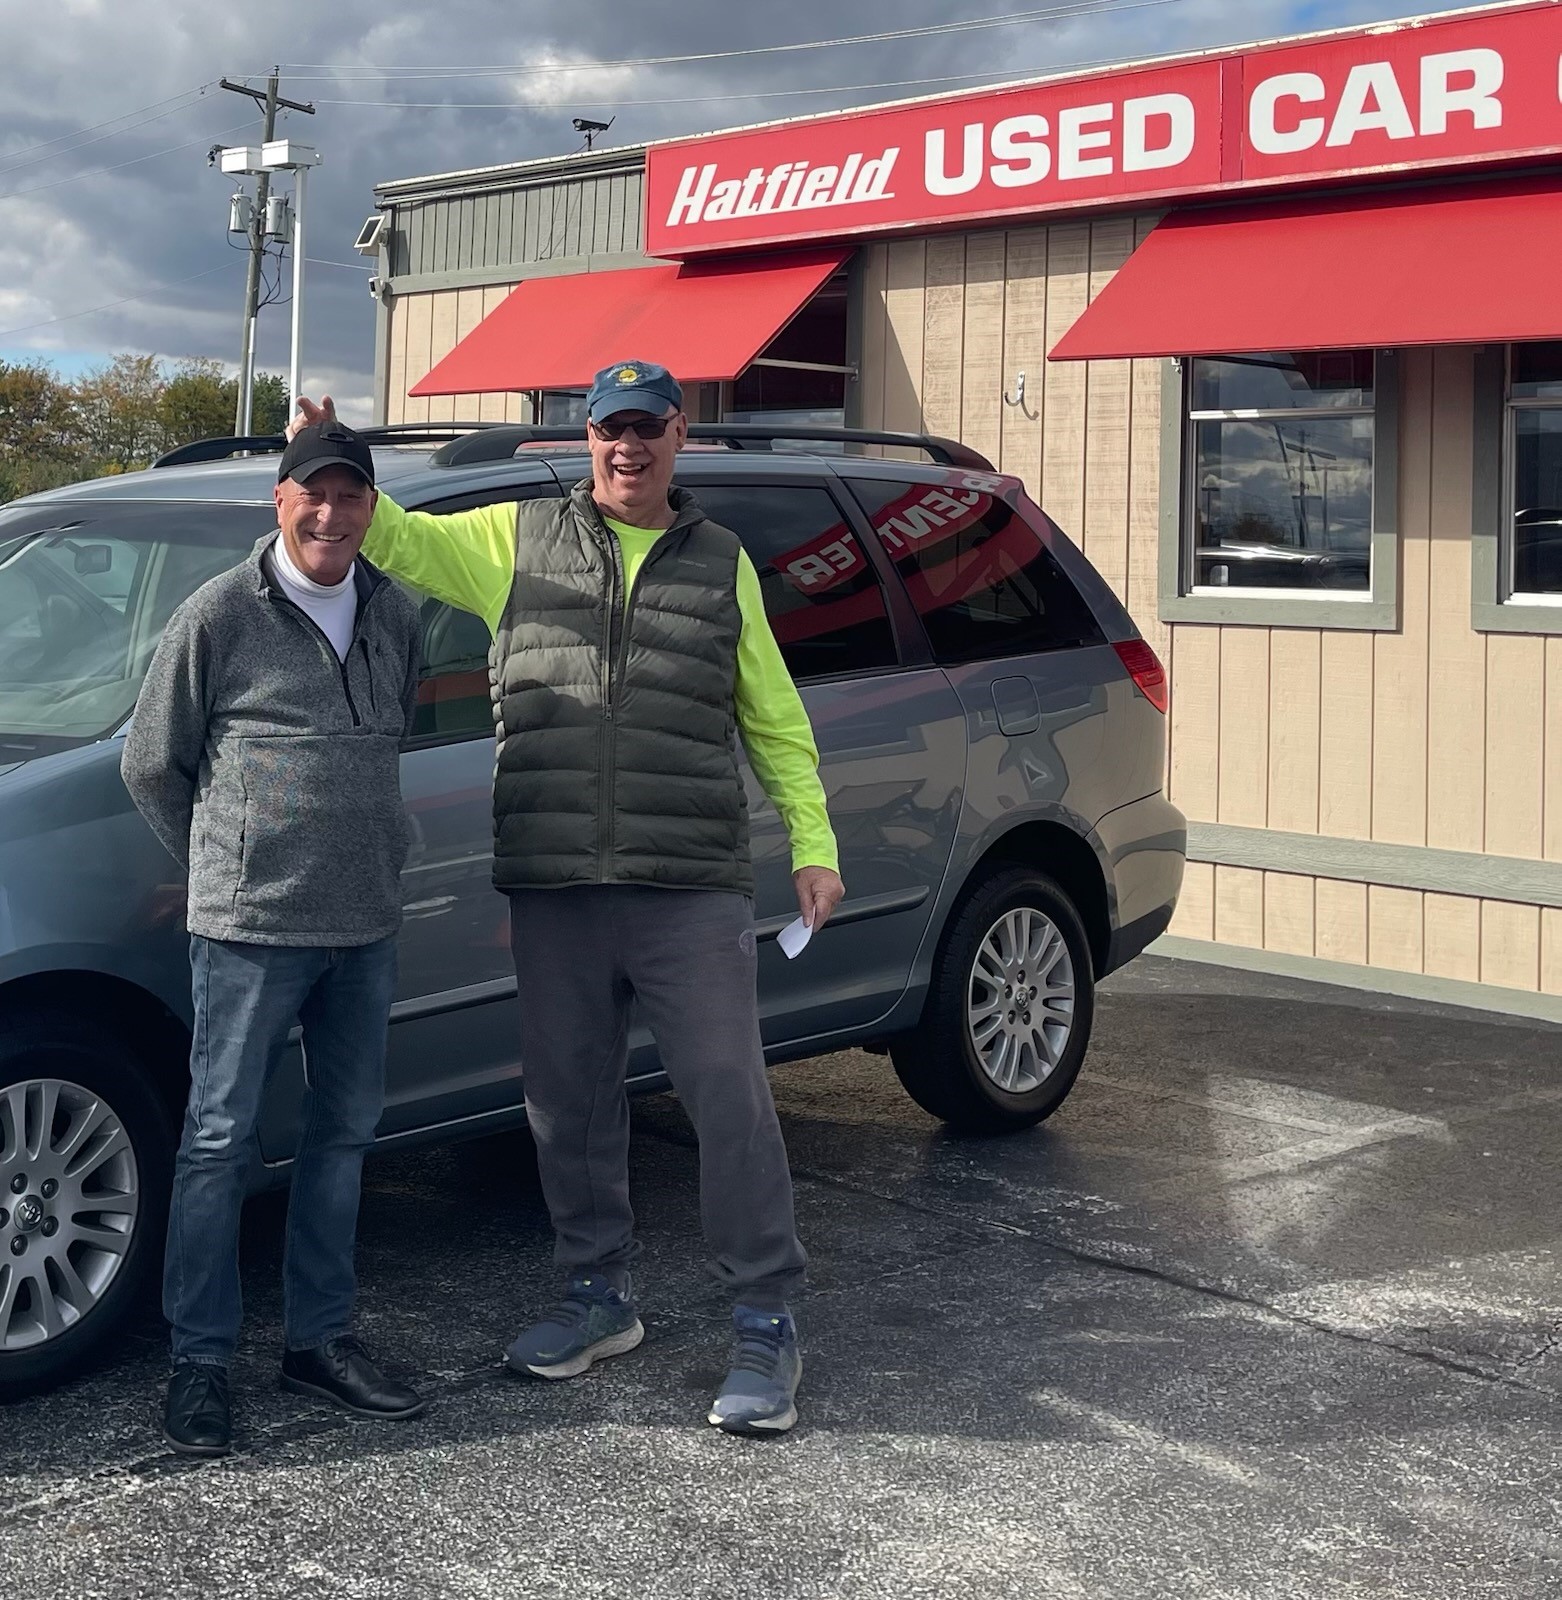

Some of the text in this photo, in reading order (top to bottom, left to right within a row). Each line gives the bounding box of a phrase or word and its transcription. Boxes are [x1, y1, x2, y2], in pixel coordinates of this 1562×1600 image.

[666, 147, 901, 227] Hatfield
[924, 93, 1195, 196] USED
[1248, 48, 1504, 155] CAR
